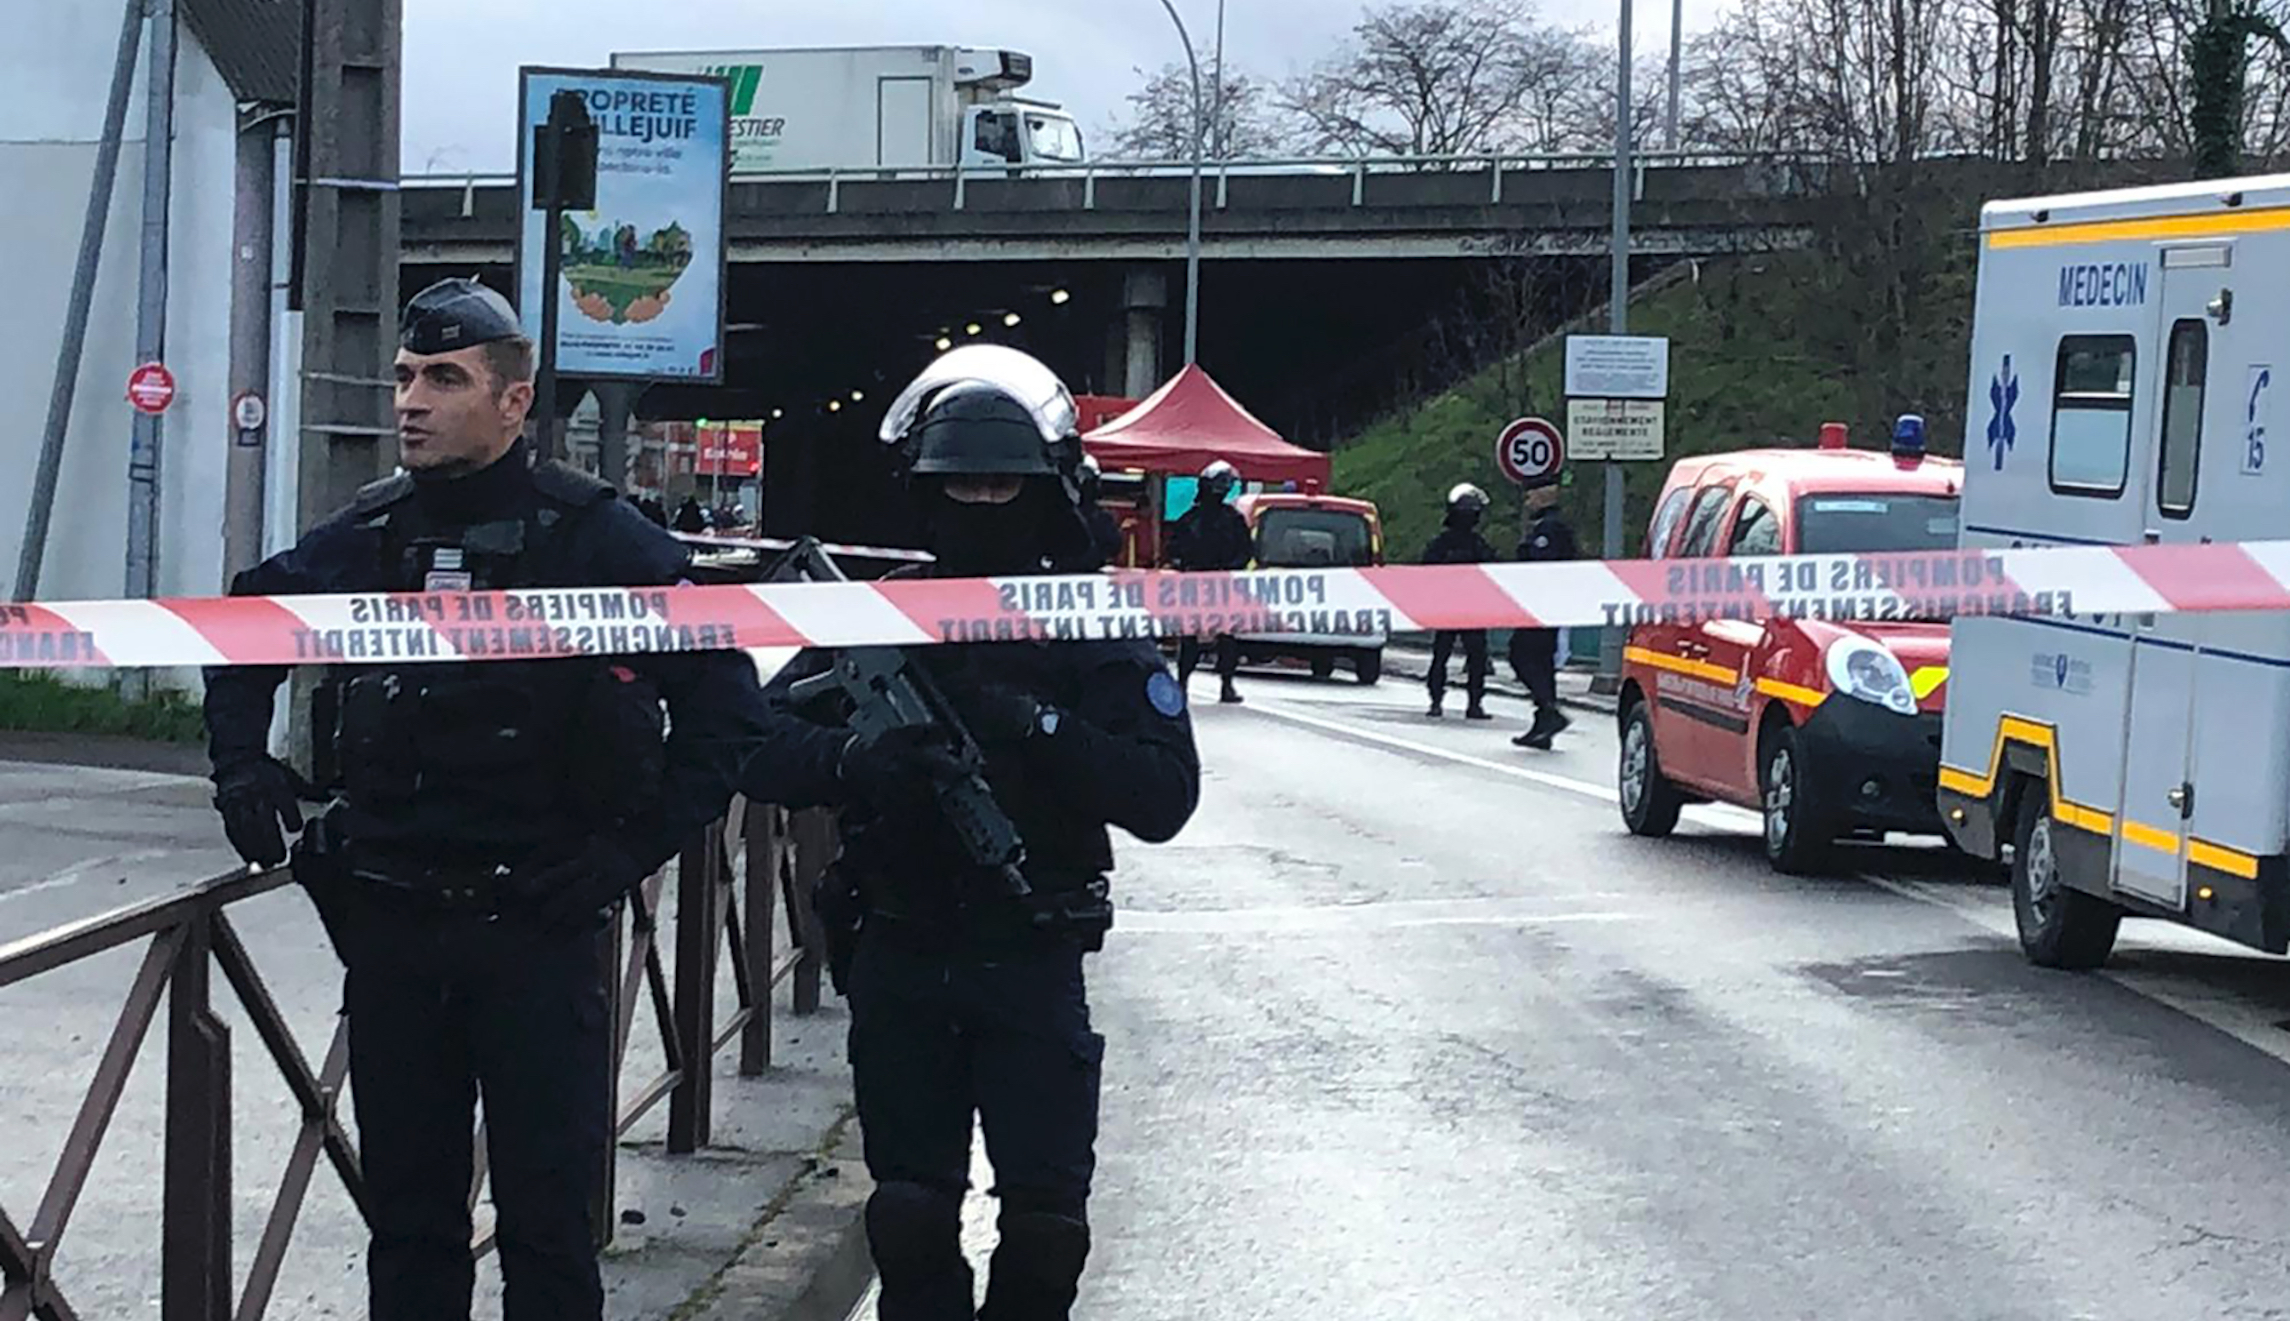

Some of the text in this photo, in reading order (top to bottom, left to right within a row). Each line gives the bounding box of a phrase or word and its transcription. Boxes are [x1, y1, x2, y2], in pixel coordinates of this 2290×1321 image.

[2059, 262, 2148, 306] MEDECIN
[1513, 439, 1549, 466] 50
[2248, 426, 2264, 469] 15
